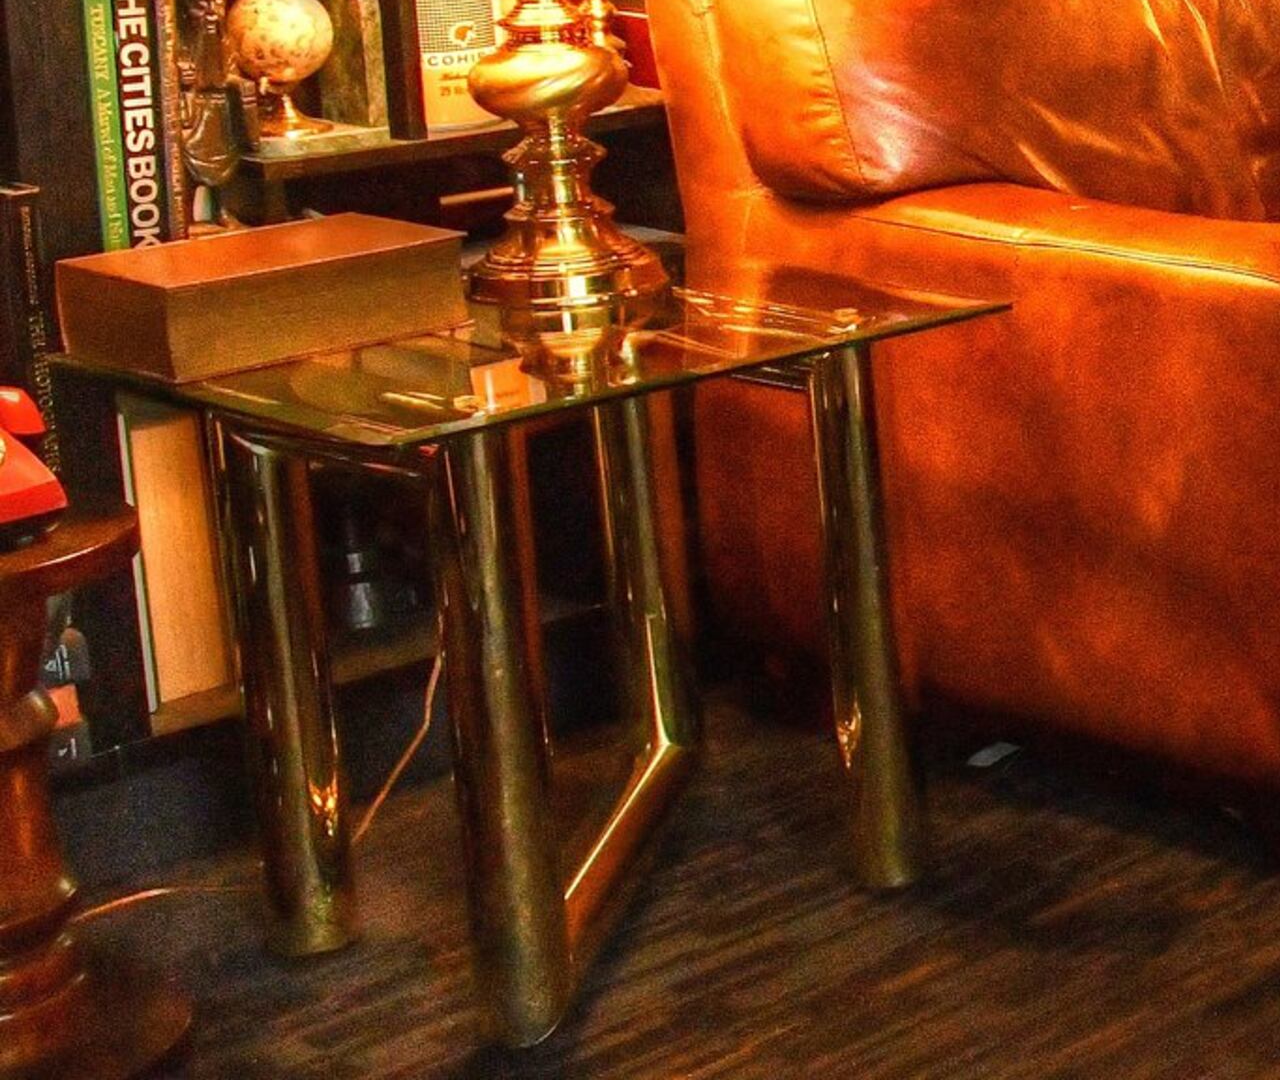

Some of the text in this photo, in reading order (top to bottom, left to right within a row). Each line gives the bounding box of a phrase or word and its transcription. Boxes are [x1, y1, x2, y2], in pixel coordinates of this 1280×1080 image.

[90, 3, 110, 80] TUSCANY
[97, 89, 111, 100] A
[98, 102, 115, 144] Marvel
[120, 41, 156, 153] CITIES
[104, 147, 117, 164] of
[128, 154, 161, 248] BOOK
